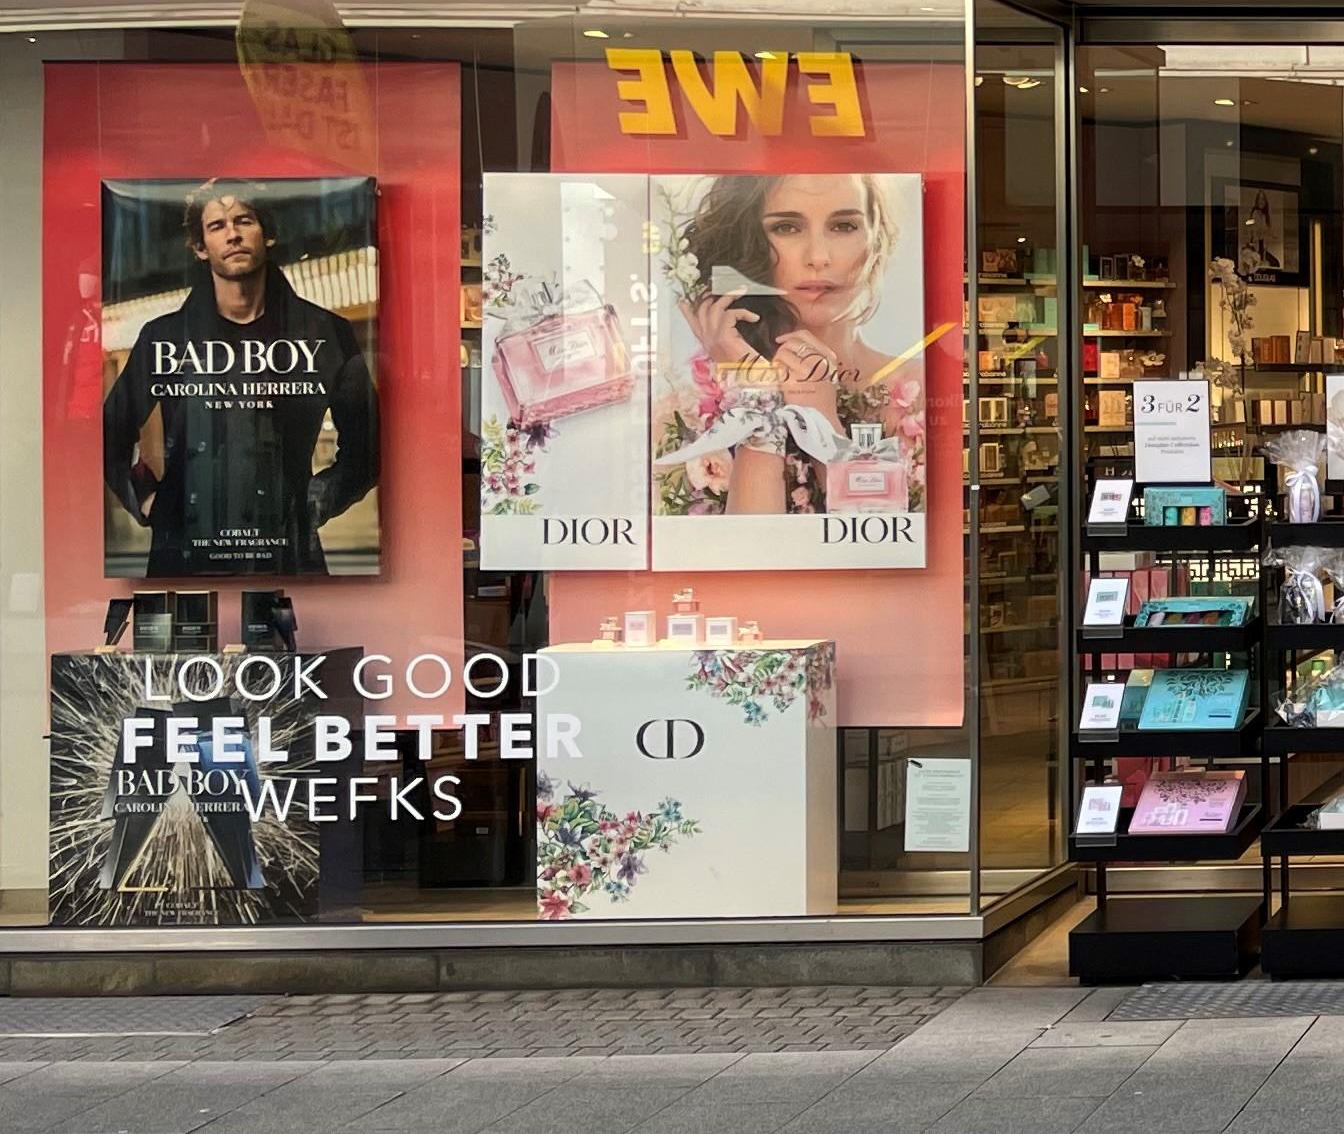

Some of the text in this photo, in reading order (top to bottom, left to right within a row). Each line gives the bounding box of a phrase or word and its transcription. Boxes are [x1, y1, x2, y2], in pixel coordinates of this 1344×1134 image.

[151, 339, 326, 376] BAD BOY
[795, 353, 862, 383] Dior
[150, 381, 327, 397] CAROLINA HERRERA
[204, 400, 274, 410] NEW YORK
[1140, 394, 1155, 414] 3
[1157, 400, 1183, 414] FÜR
[191, 538, 211, 547] THE
[219, 528, 260, 537] COBALT
[542, 517, 637, 546] DIOR
[821, 516, 915, 544] DIOR
[145, 653, 561, 702] LOOK GOOD
[122, 713, 583, 765] FEEL BETTER
[115, 768, 251, 796] BAD BOY
[113, 801, 252, 813] CAROLI ERRERA
